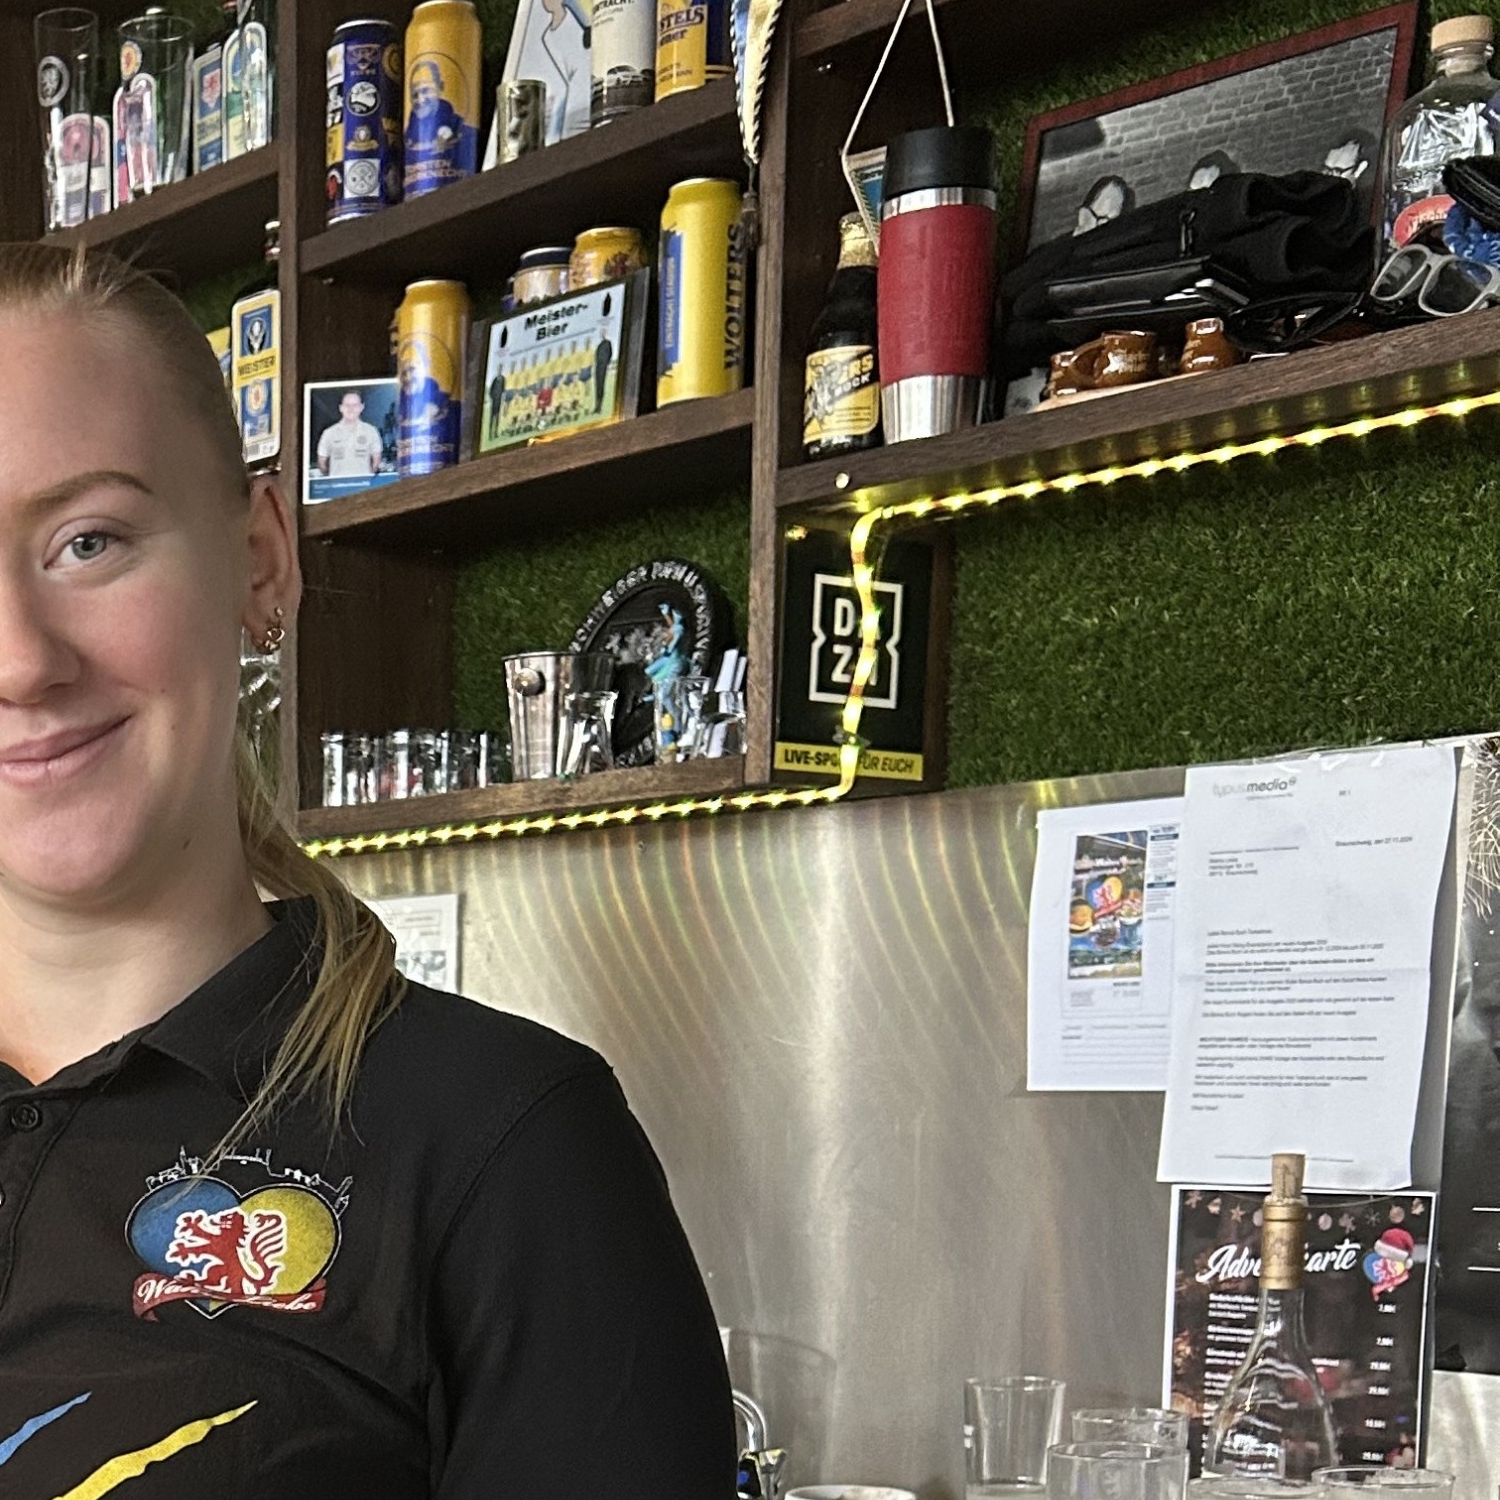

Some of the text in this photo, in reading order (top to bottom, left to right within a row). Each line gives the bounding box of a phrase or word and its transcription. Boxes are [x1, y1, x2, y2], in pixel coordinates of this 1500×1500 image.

[724, 223, 748, 370] WOLTERS
[524, 302, 589, 330] Meister-
[536, 322, 568, 341] Bier
[881, 756, 915, 774] EUCH
